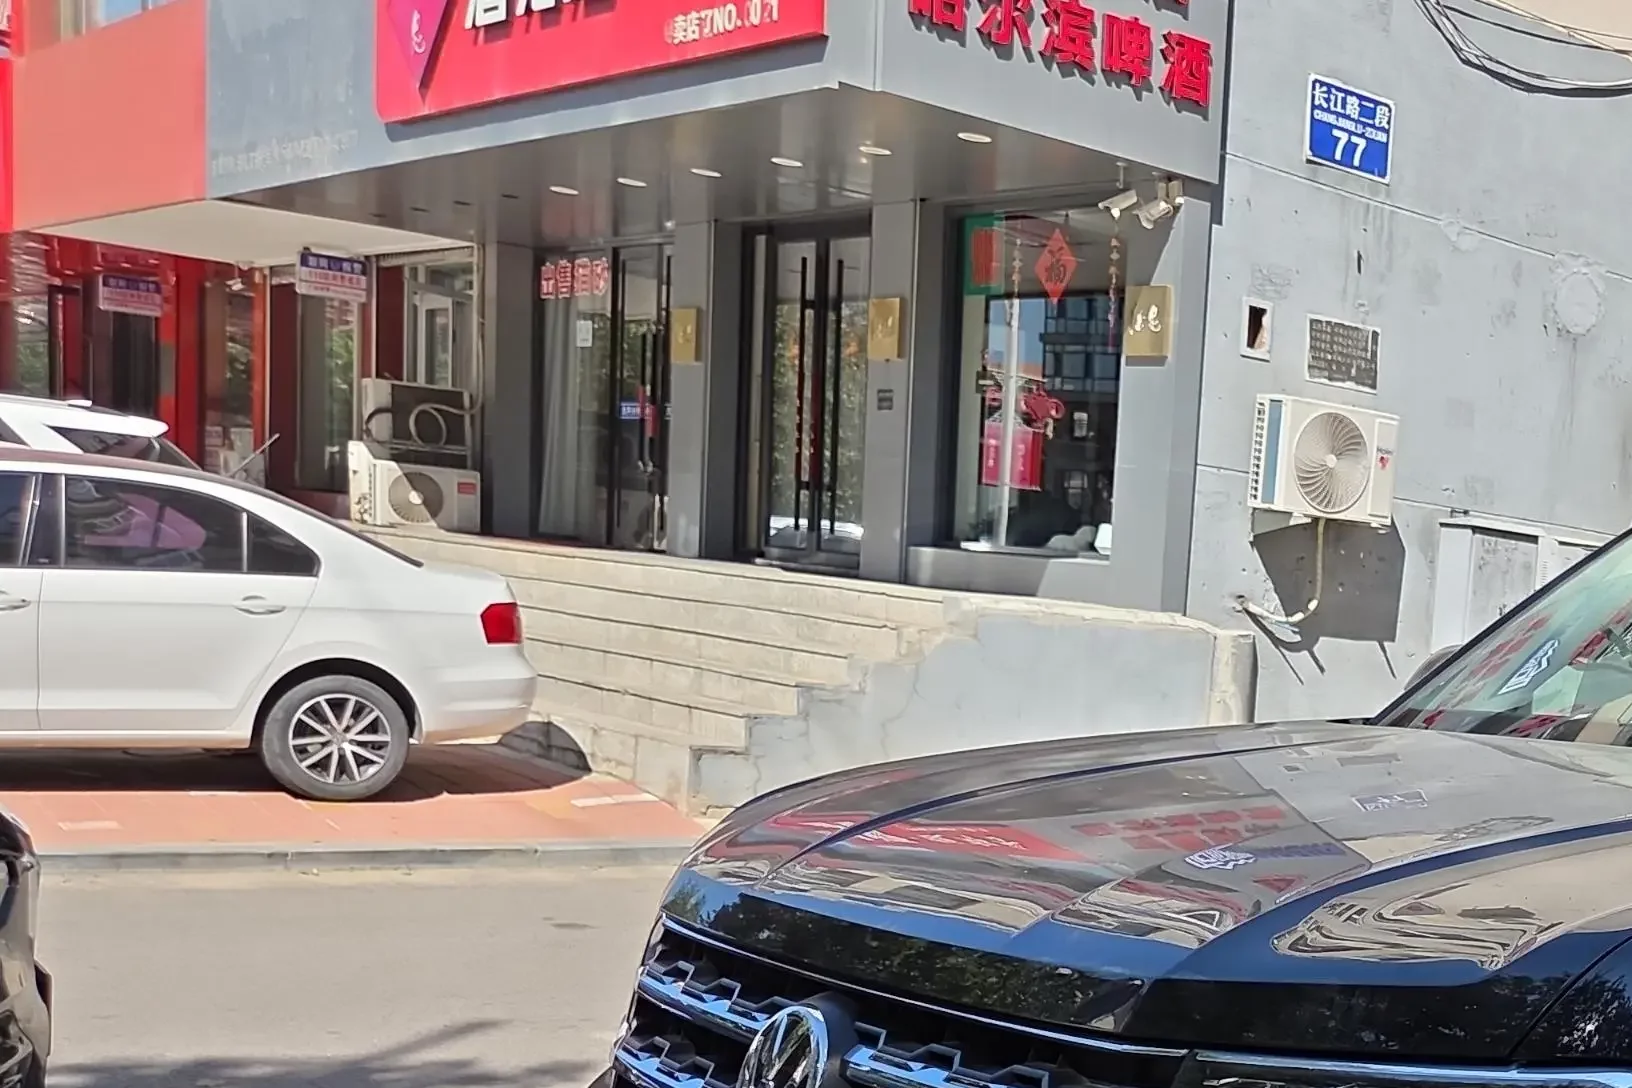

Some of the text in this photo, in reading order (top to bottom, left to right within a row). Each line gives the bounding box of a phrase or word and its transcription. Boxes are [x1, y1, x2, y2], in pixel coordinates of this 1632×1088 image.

[1312, 82, 1389, 129] 长江路二段
[1332, 128, 1367, 167] 77
